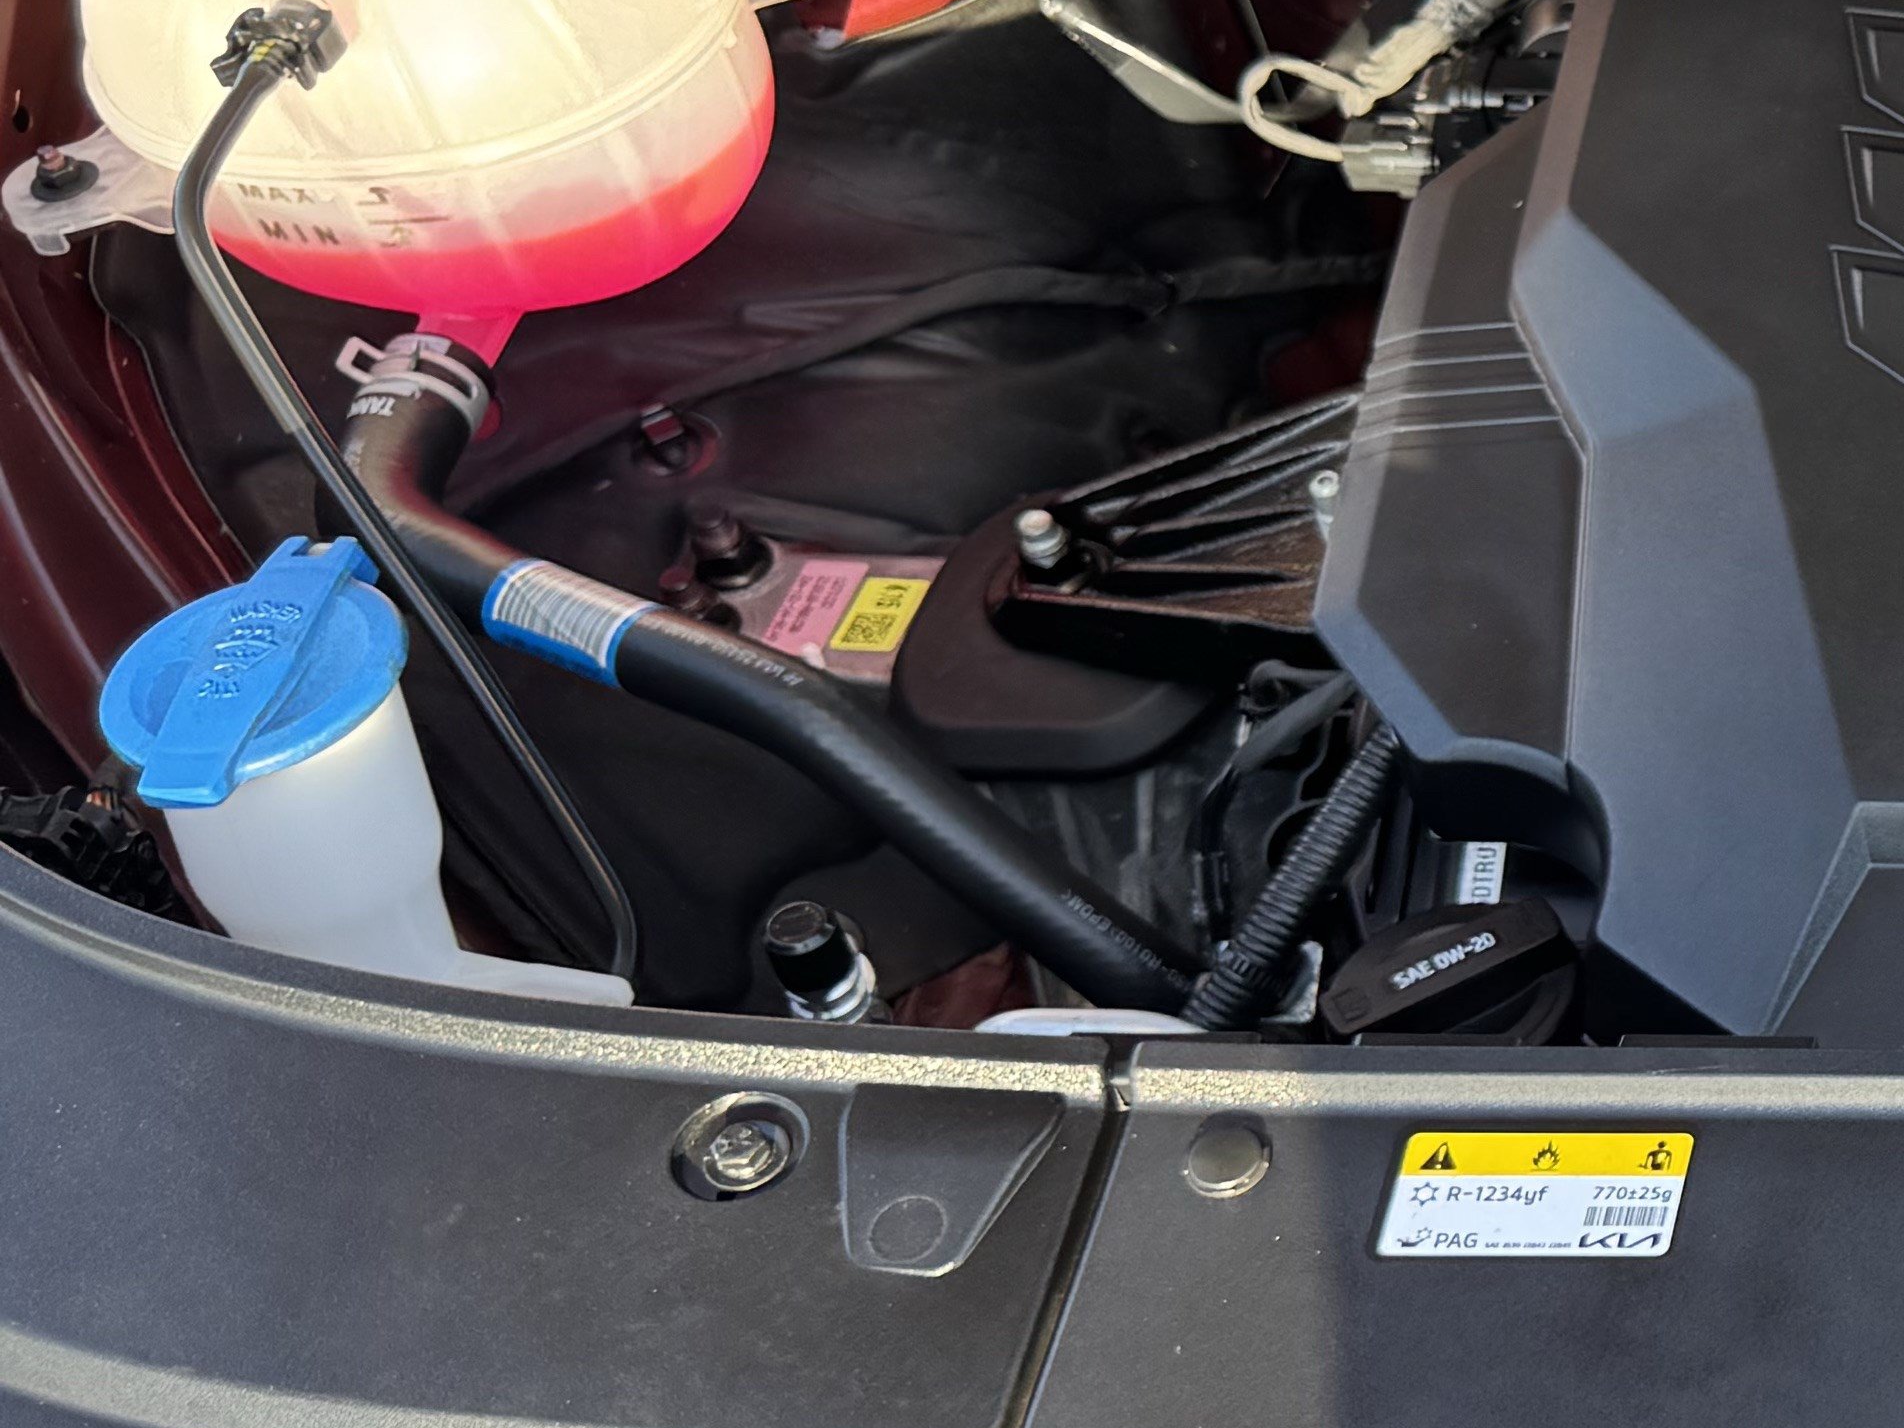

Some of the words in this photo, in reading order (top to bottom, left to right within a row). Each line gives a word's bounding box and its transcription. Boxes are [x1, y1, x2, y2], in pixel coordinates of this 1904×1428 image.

[237, 182, 316, 205] MAX
[257, 218, 341, 247] MIN
[230, 600, 303, 625] WASHER
[1391, 960, 1435, 990] SAE
[1432, 932, 1497, 970] 0W-20
[1446, 1185, 1550, 1207] R-1234yf
[1591, 1185, 1673, 1203] 770±25g
[1434, 1232, 1479, 1249] PAG
